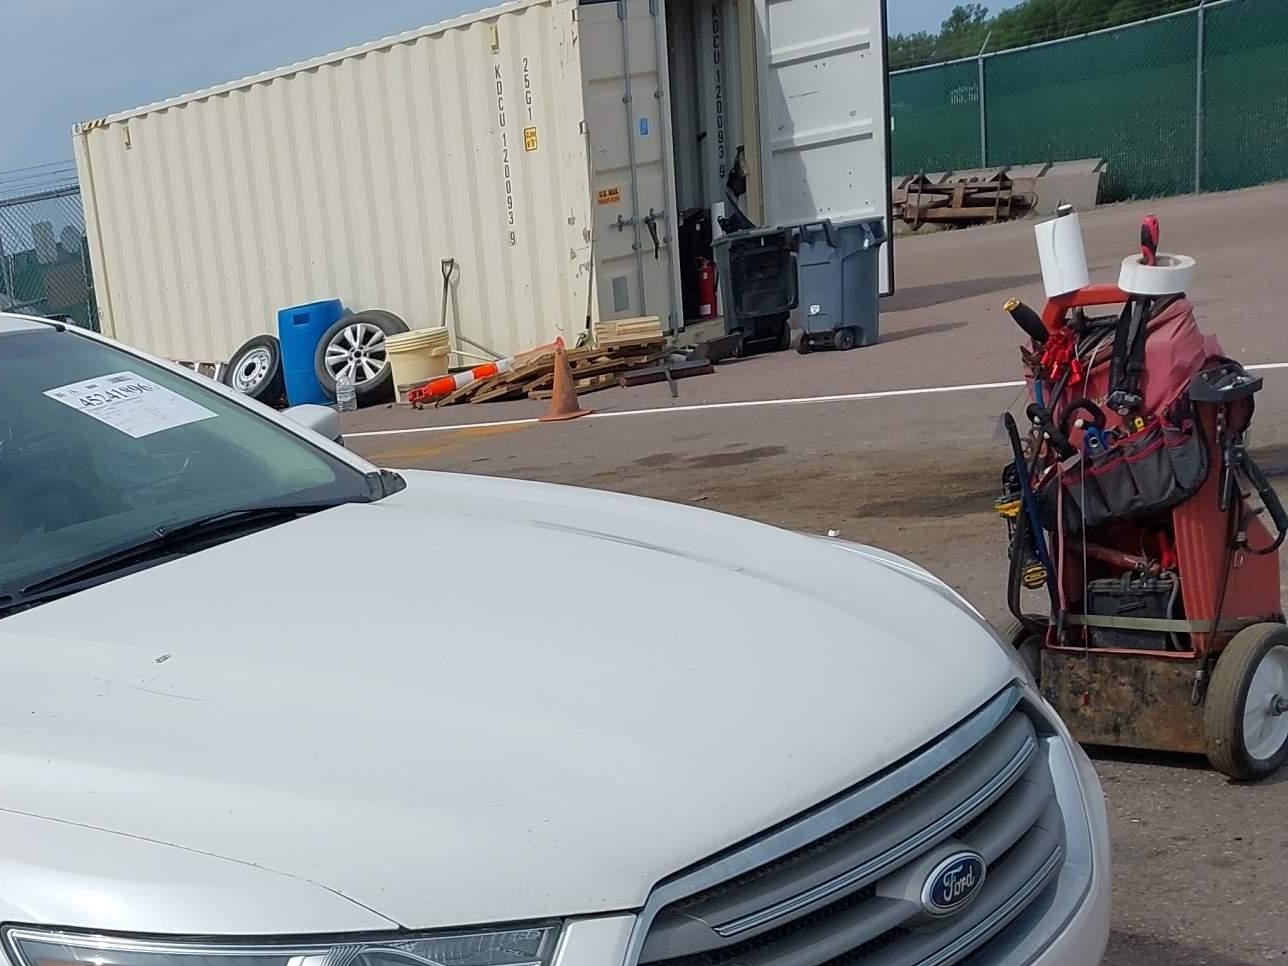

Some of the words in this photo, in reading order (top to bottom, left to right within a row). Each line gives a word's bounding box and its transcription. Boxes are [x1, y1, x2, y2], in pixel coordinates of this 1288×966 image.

[522, 57, 532, 121] 25G1
[494, 63, 506, 127] KDCU
[501, 132, 514, 225] 120093
[509, 230, 516, 245] 9
[78, 382, 149, 409] 45241896
[943, 863, 976, 902] Ford
